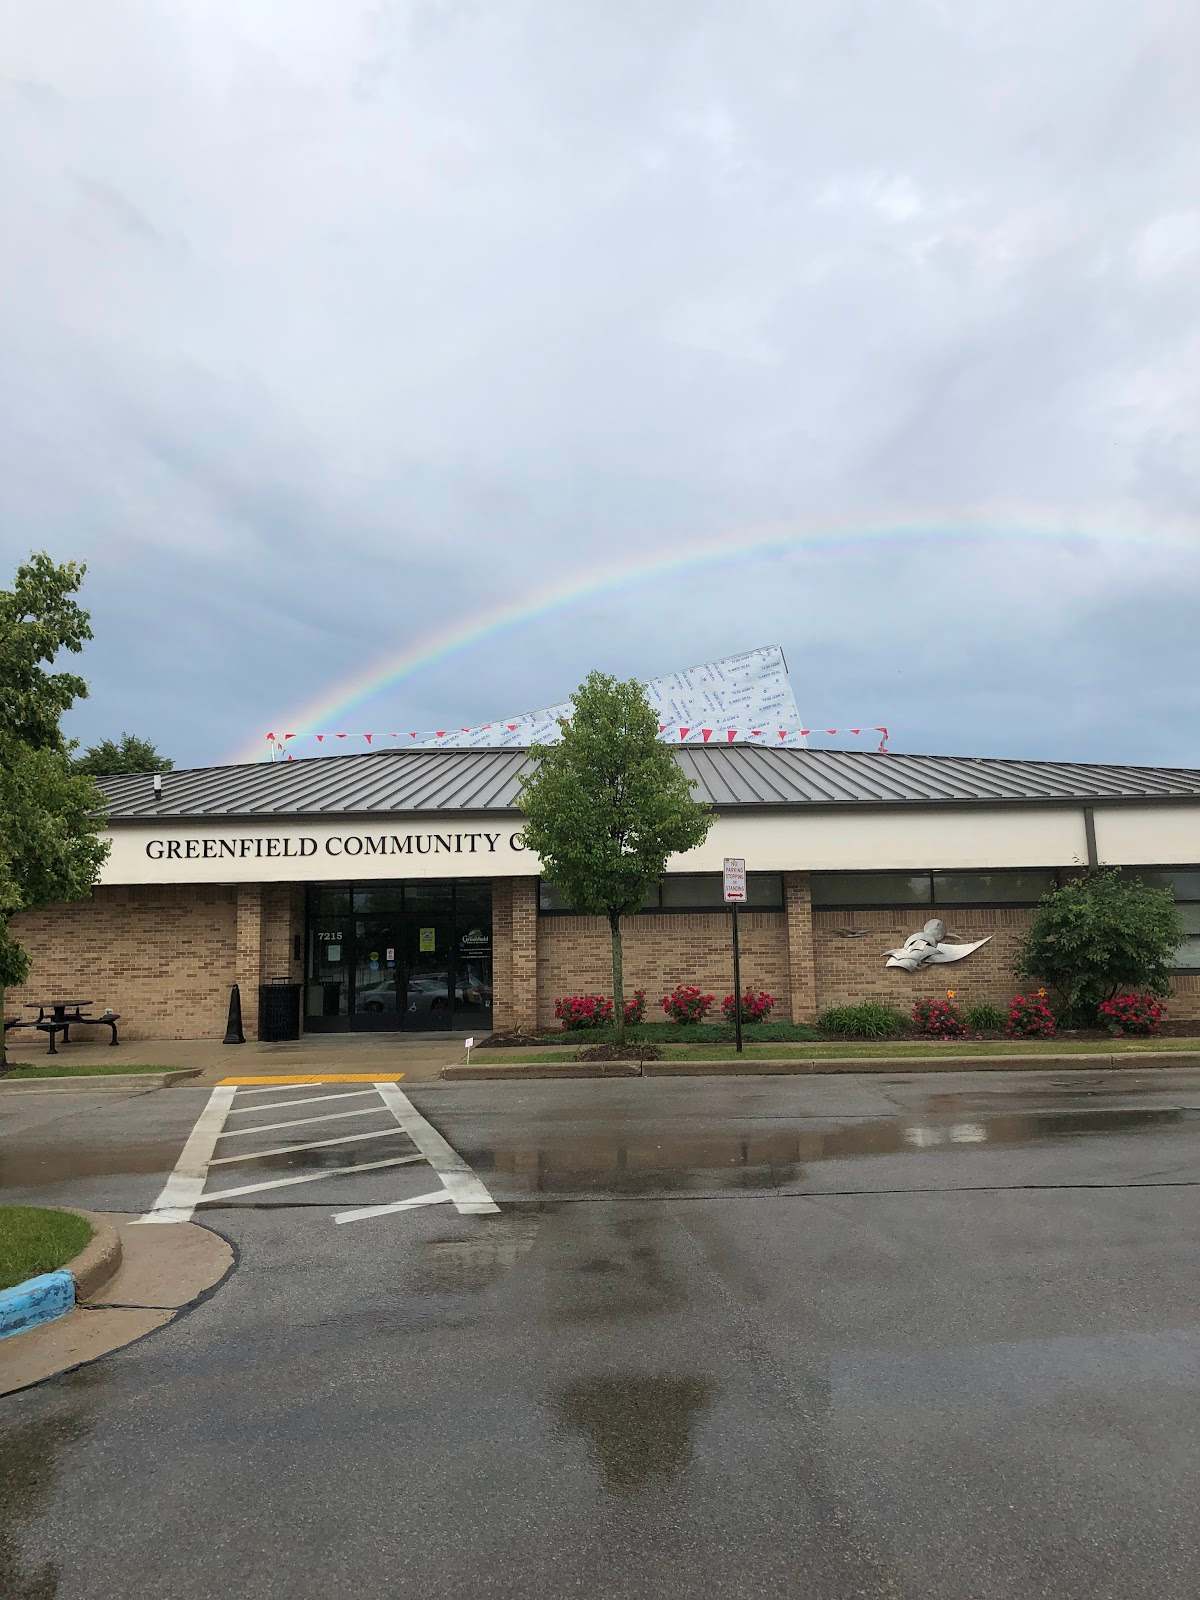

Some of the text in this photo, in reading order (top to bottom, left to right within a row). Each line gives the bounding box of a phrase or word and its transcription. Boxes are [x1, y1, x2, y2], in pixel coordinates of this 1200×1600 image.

[146, 837, 318, 859] GREENFIELD
[325, 833, 501, 856] COMMUNITY
[318, 932, 343, 940] 7215
